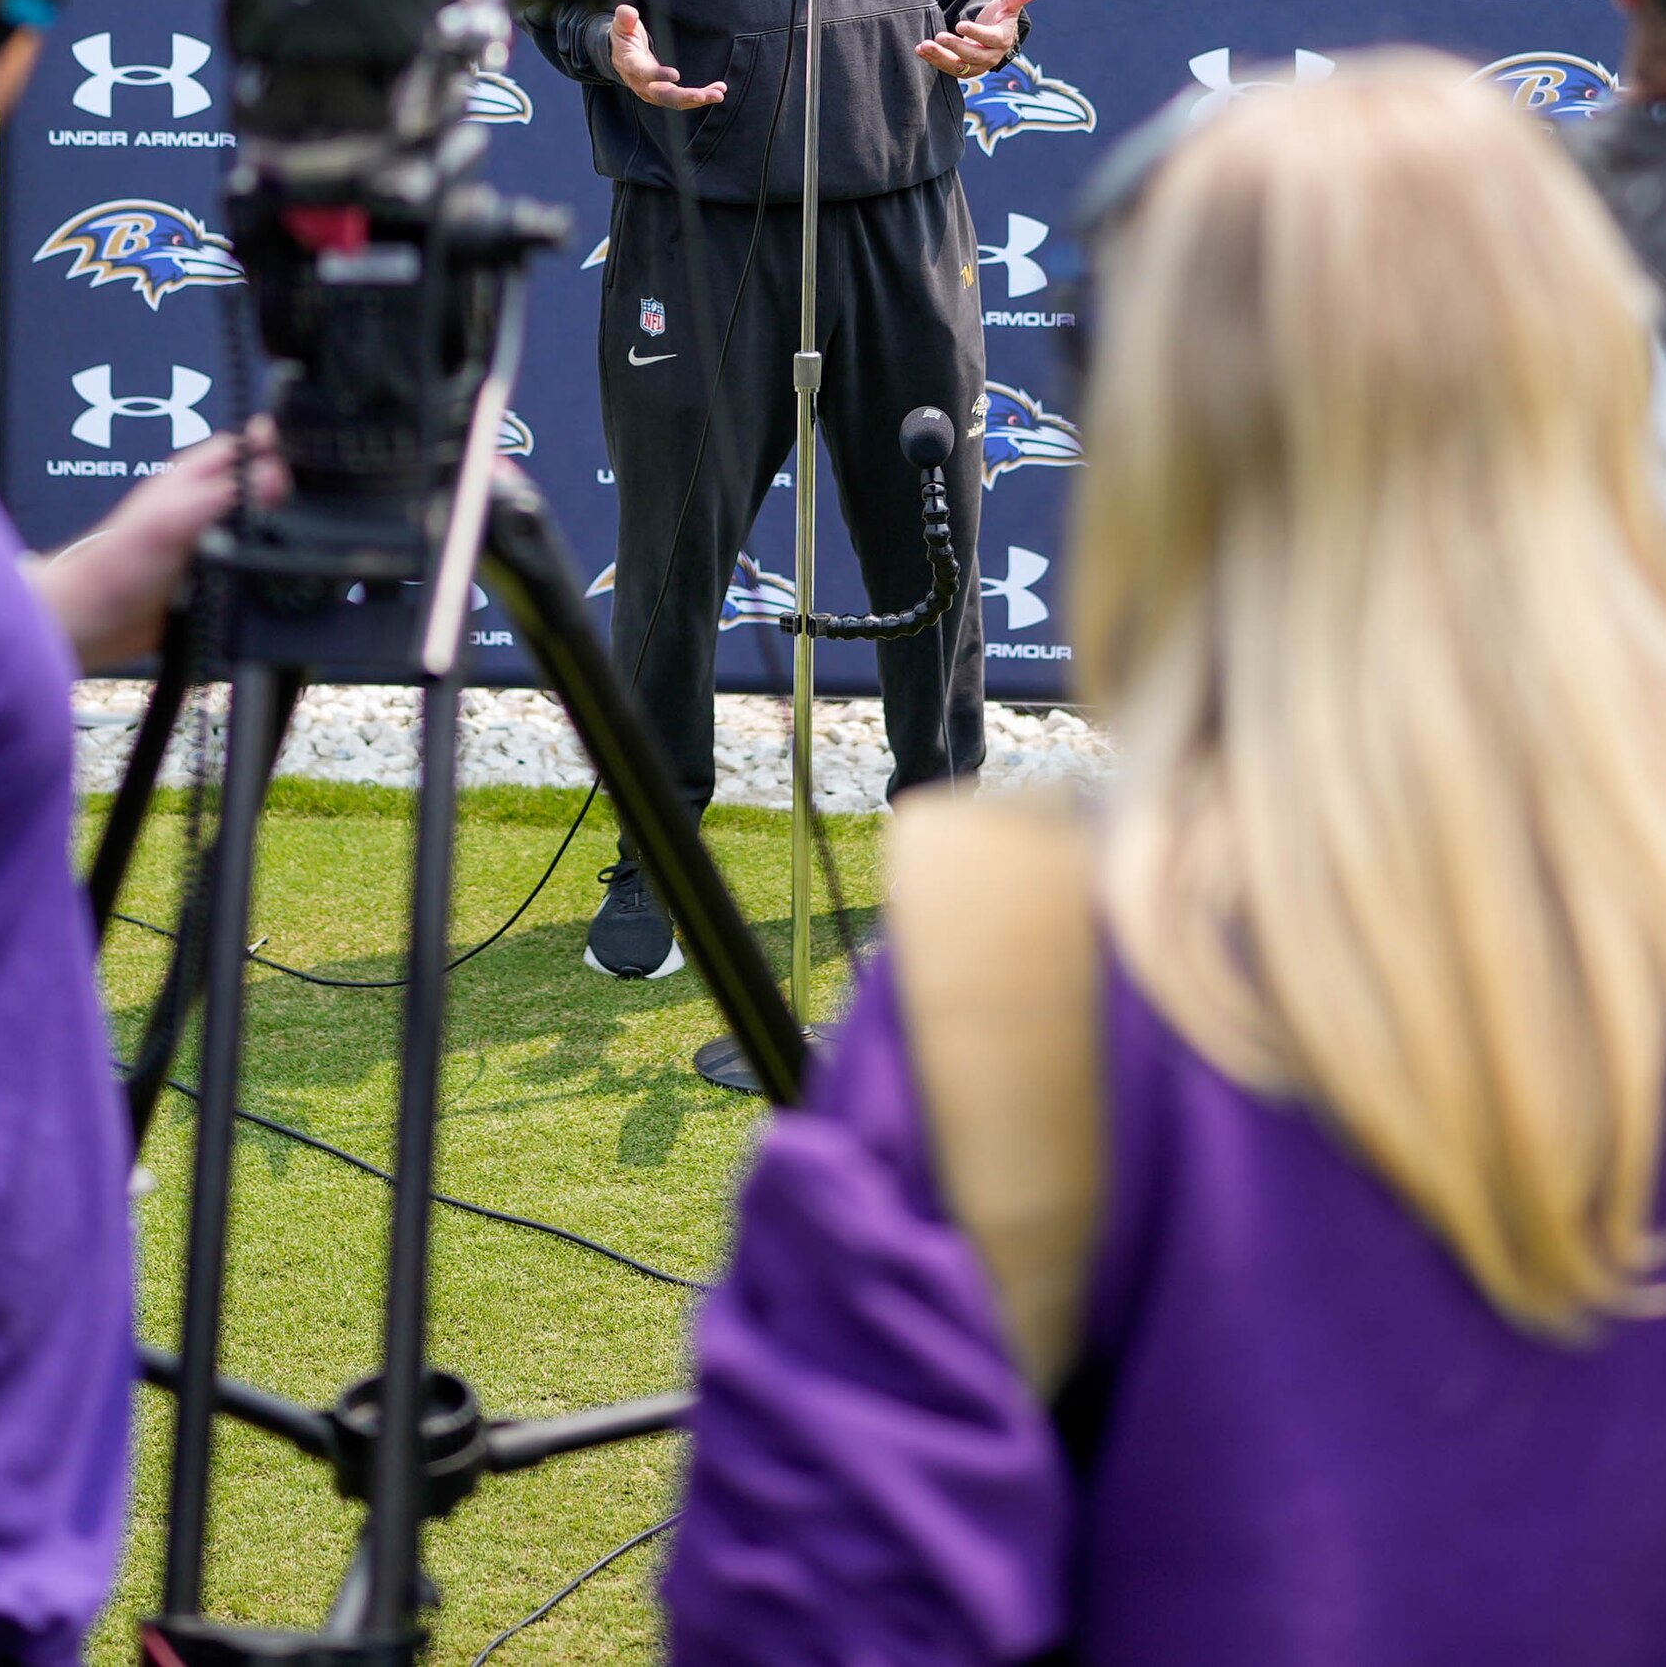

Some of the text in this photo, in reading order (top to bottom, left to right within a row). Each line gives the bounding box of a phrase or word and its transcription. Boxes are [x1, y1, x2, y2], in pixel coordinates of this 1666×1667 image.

[48, 130, 237, 148] UNDER ARMOUR
[643, 311, 663, 331] NFL
[981, 311, 1075, 327] RMOUR
[46, 460, 127, 476] UNDER
[985, 643, 1072, 660] RMOUR
